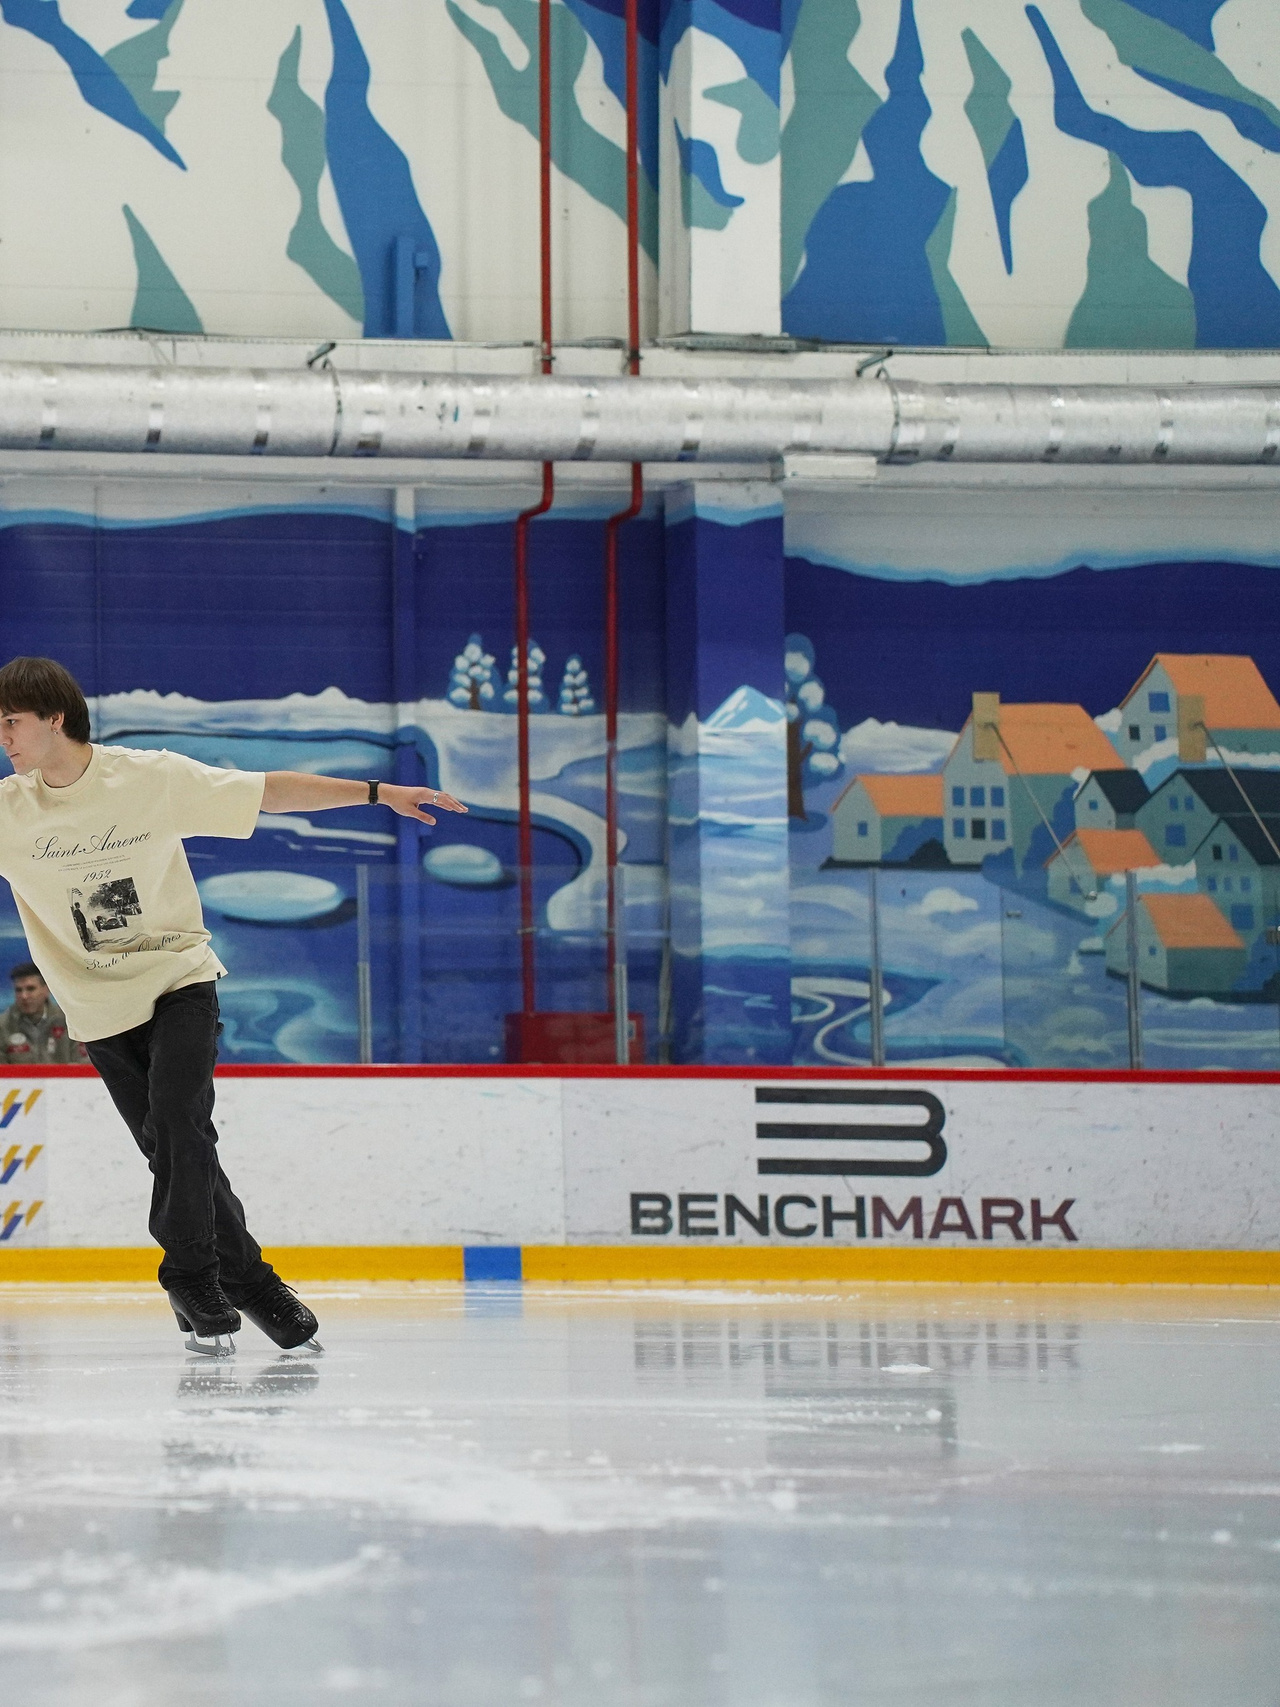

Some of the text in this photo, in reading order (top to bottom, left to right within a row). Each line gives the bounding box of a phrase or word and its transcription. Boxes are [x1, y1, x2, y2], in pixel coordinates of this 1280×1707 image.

[32, 824, 152, 861] Saint-Aurence
[83, 869, 112, 882] 1952
[630, 1192, 1080, 1242] BENCHMARK
